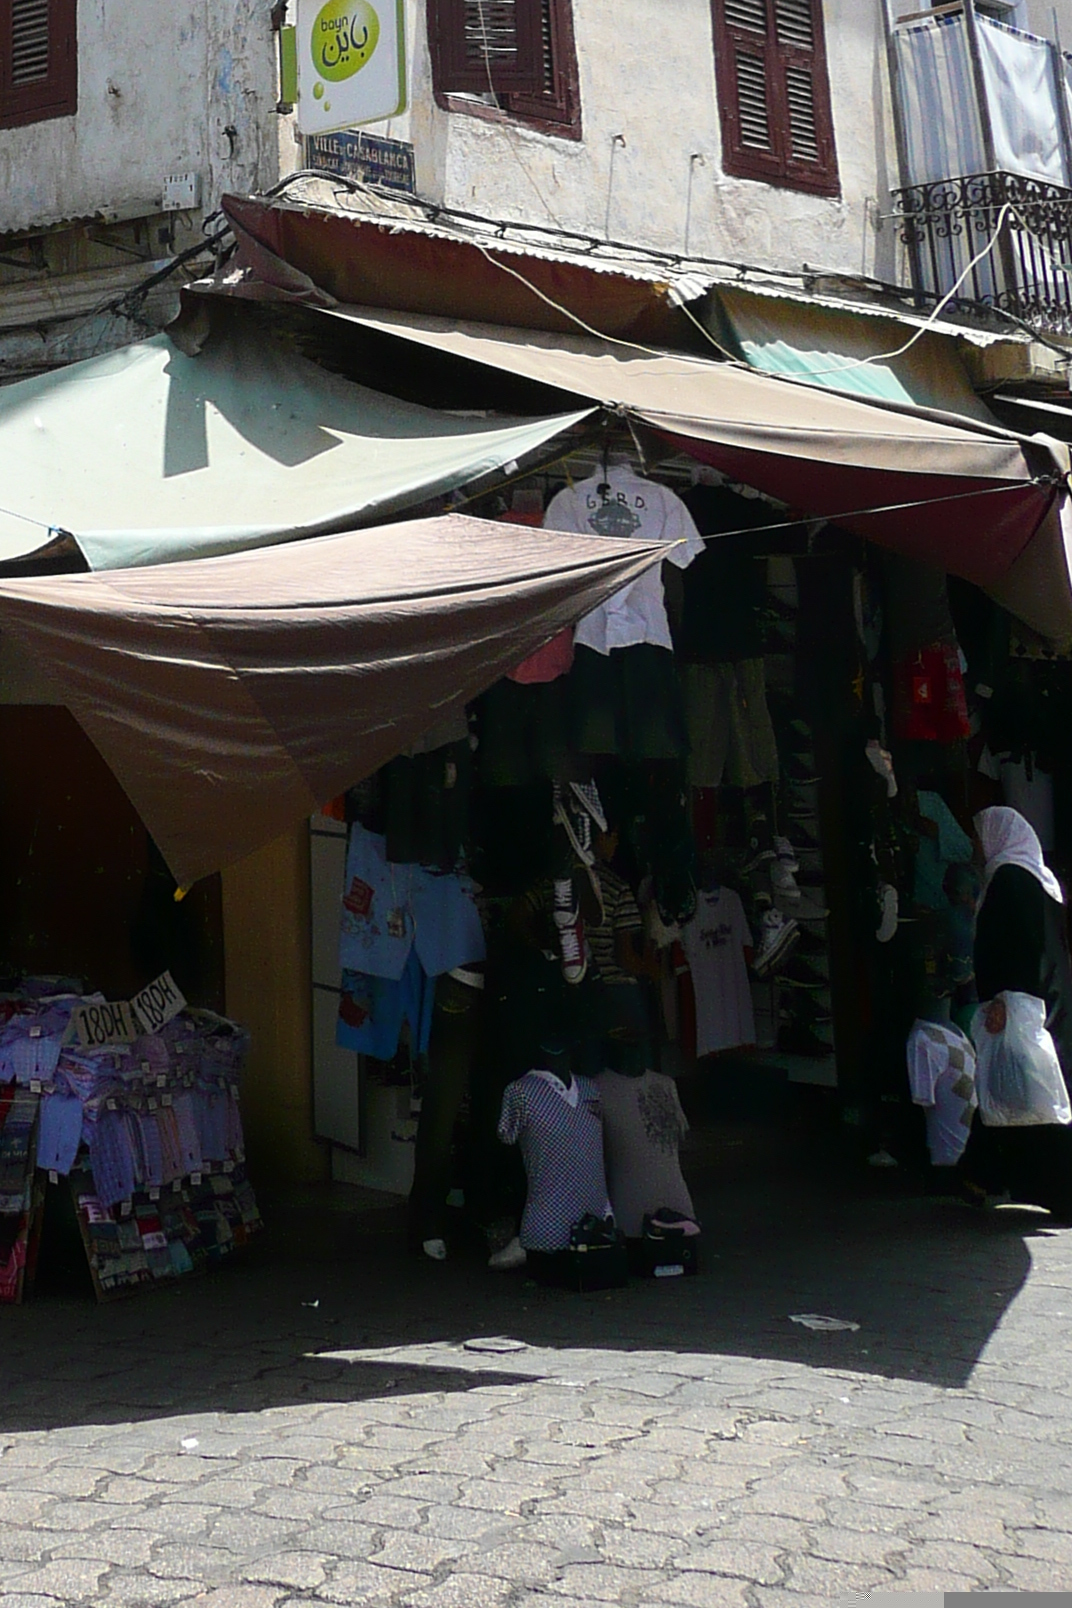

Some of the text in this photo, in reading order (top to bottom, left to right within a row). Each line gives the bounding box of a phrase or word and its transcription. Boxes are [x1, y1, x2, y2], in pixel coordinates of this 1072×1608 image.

[321, 16, 349, 33] bayn
[322, 13, 368, 67] باين
[313, 135, 339, 154] VILLE
[346, 143, 409, 169] CASABLANCA
[137, 975, 177, 1030] 18DH
[79, 1003, 128, 1045] 18DH
